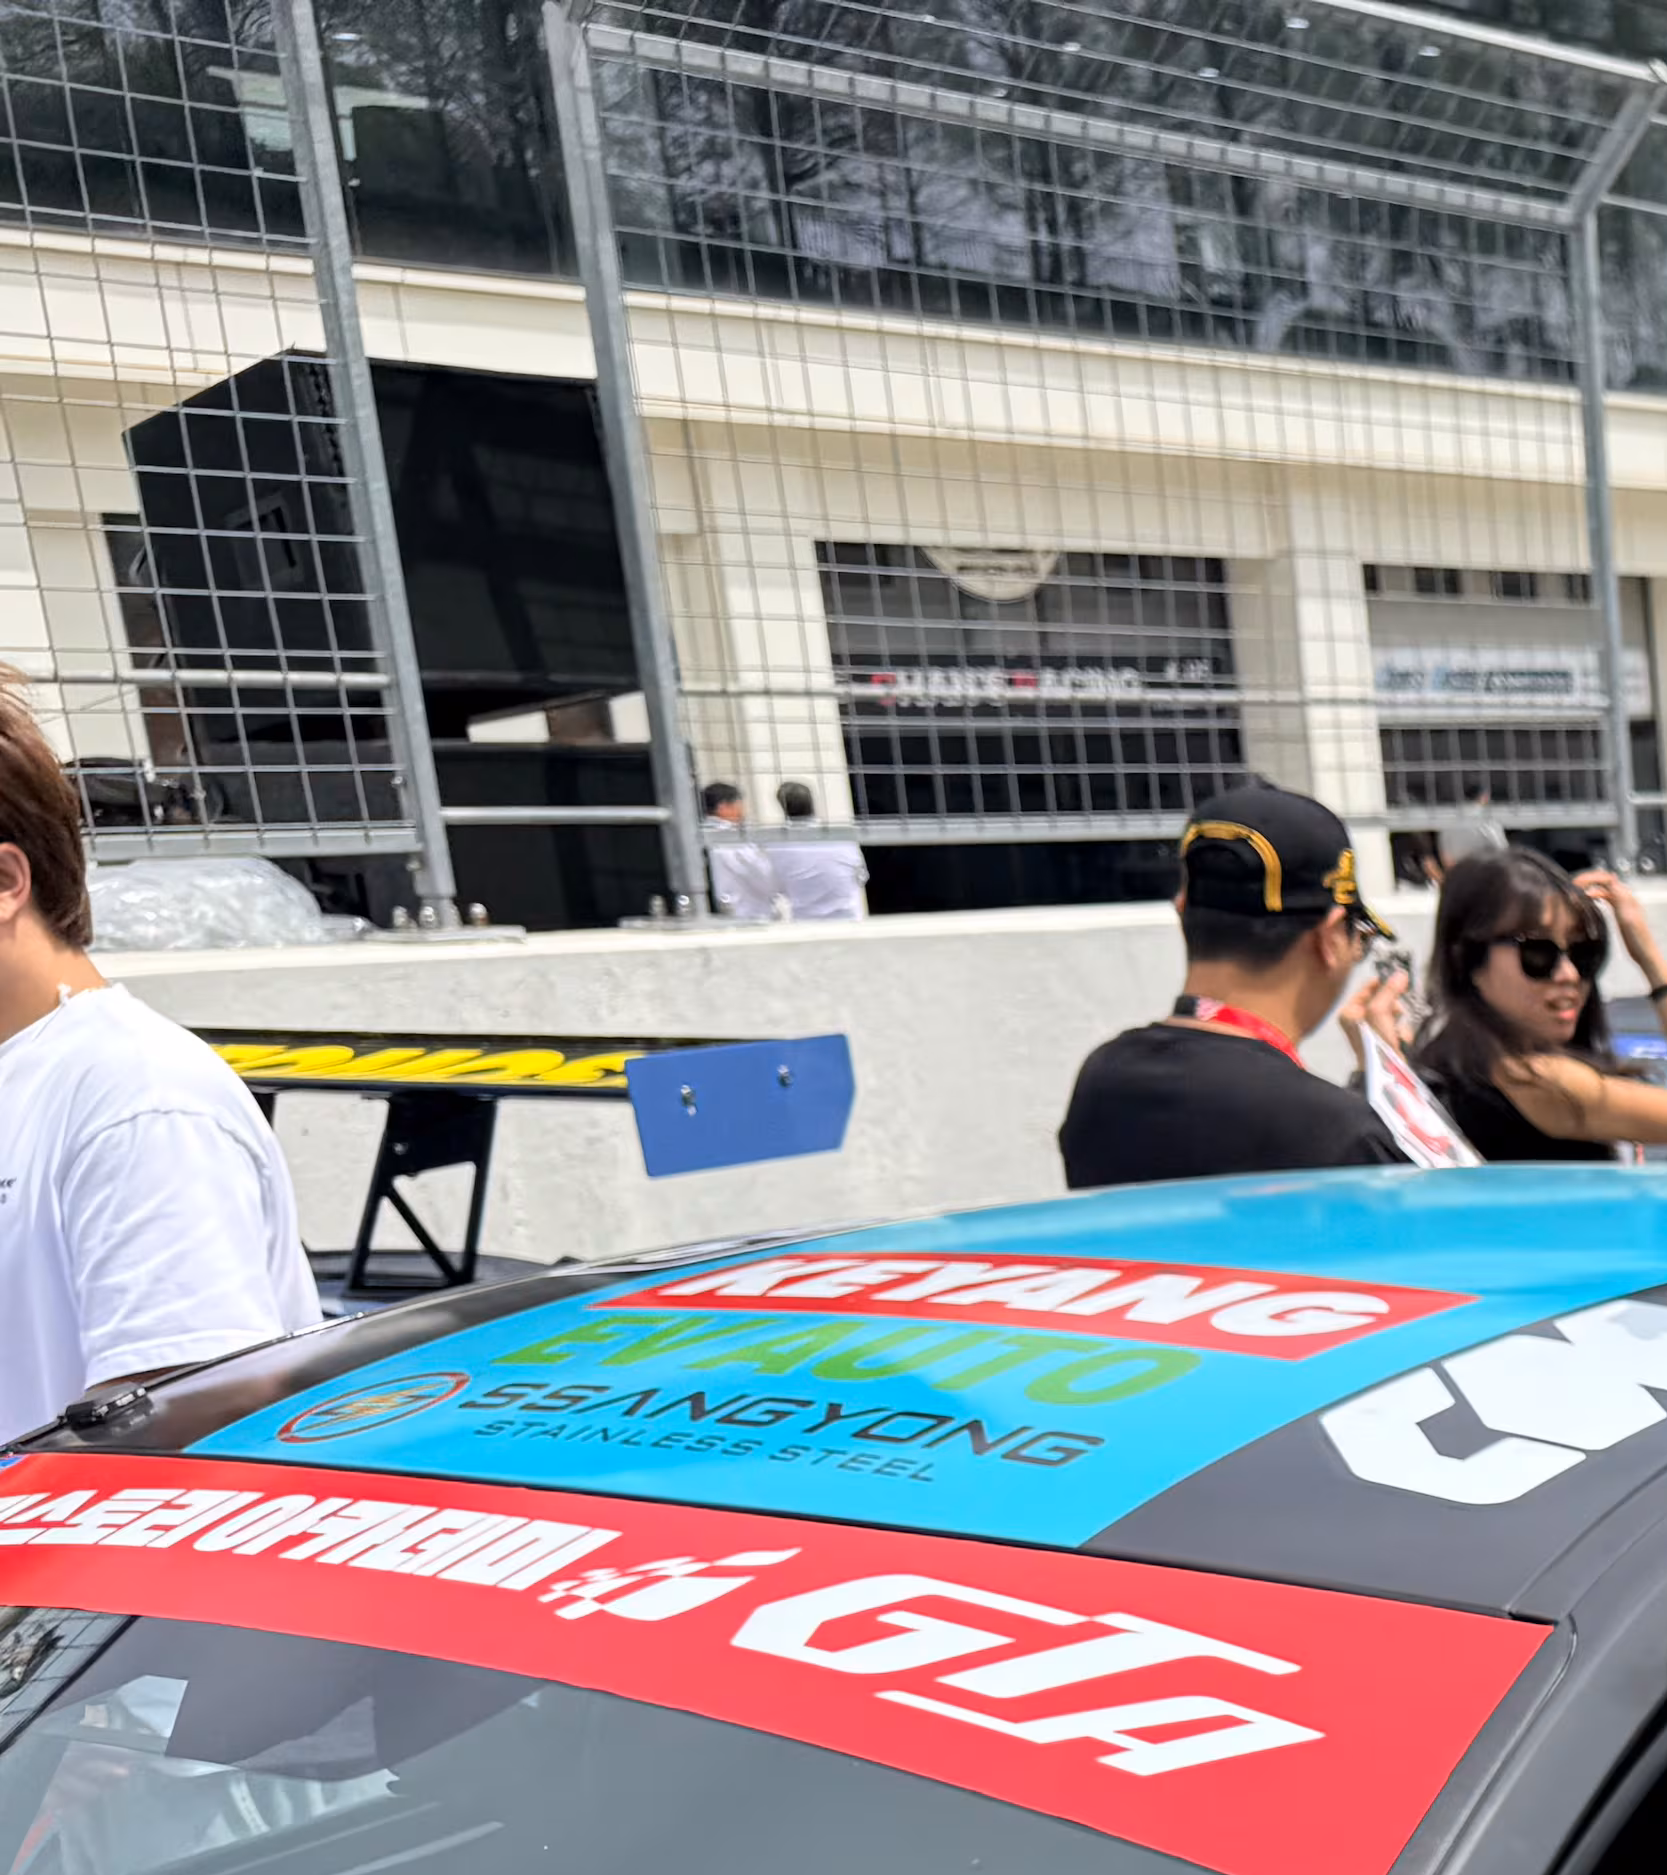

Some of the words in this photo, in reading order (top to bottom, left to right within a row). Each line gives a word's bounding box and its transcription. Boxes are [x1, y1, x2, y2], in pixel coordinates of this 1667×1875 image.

[661, 1258, 1390, 1337] KEYANG
[460, 1383, 1105, 1467] SSANGYONG
[476, 1420, 764, 1457] STAINLESS
[771, 1443, 937, 1483] STEEL
[731, 1575, 1326, 1777] GTA
